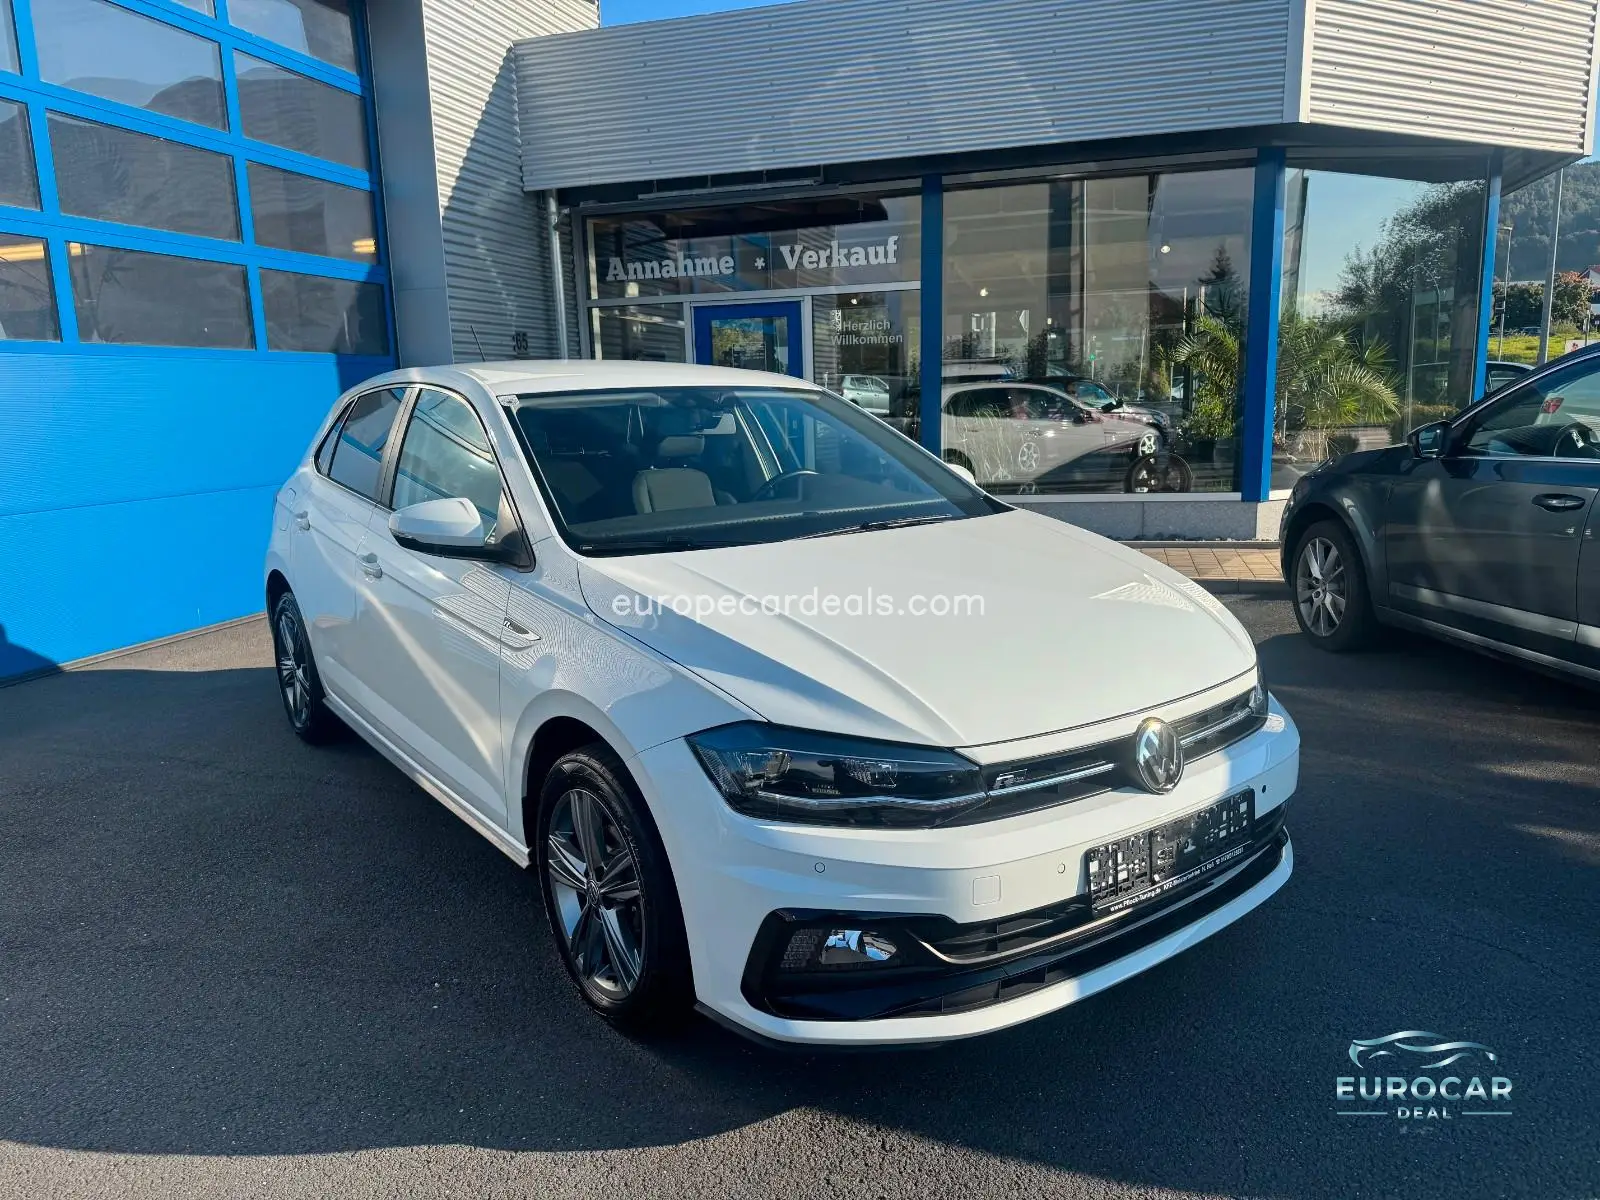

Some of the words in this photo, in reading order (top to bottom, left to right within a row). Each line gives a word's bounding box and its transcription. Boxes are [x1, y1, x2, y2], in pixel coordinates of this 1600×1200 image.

[606, 251, 734, 281] Annahme
[780, 235, 899, 270] Verkauf
[843, 319, 891, 331] Herzlich
[831, 334, 903, 345] Willkommen
